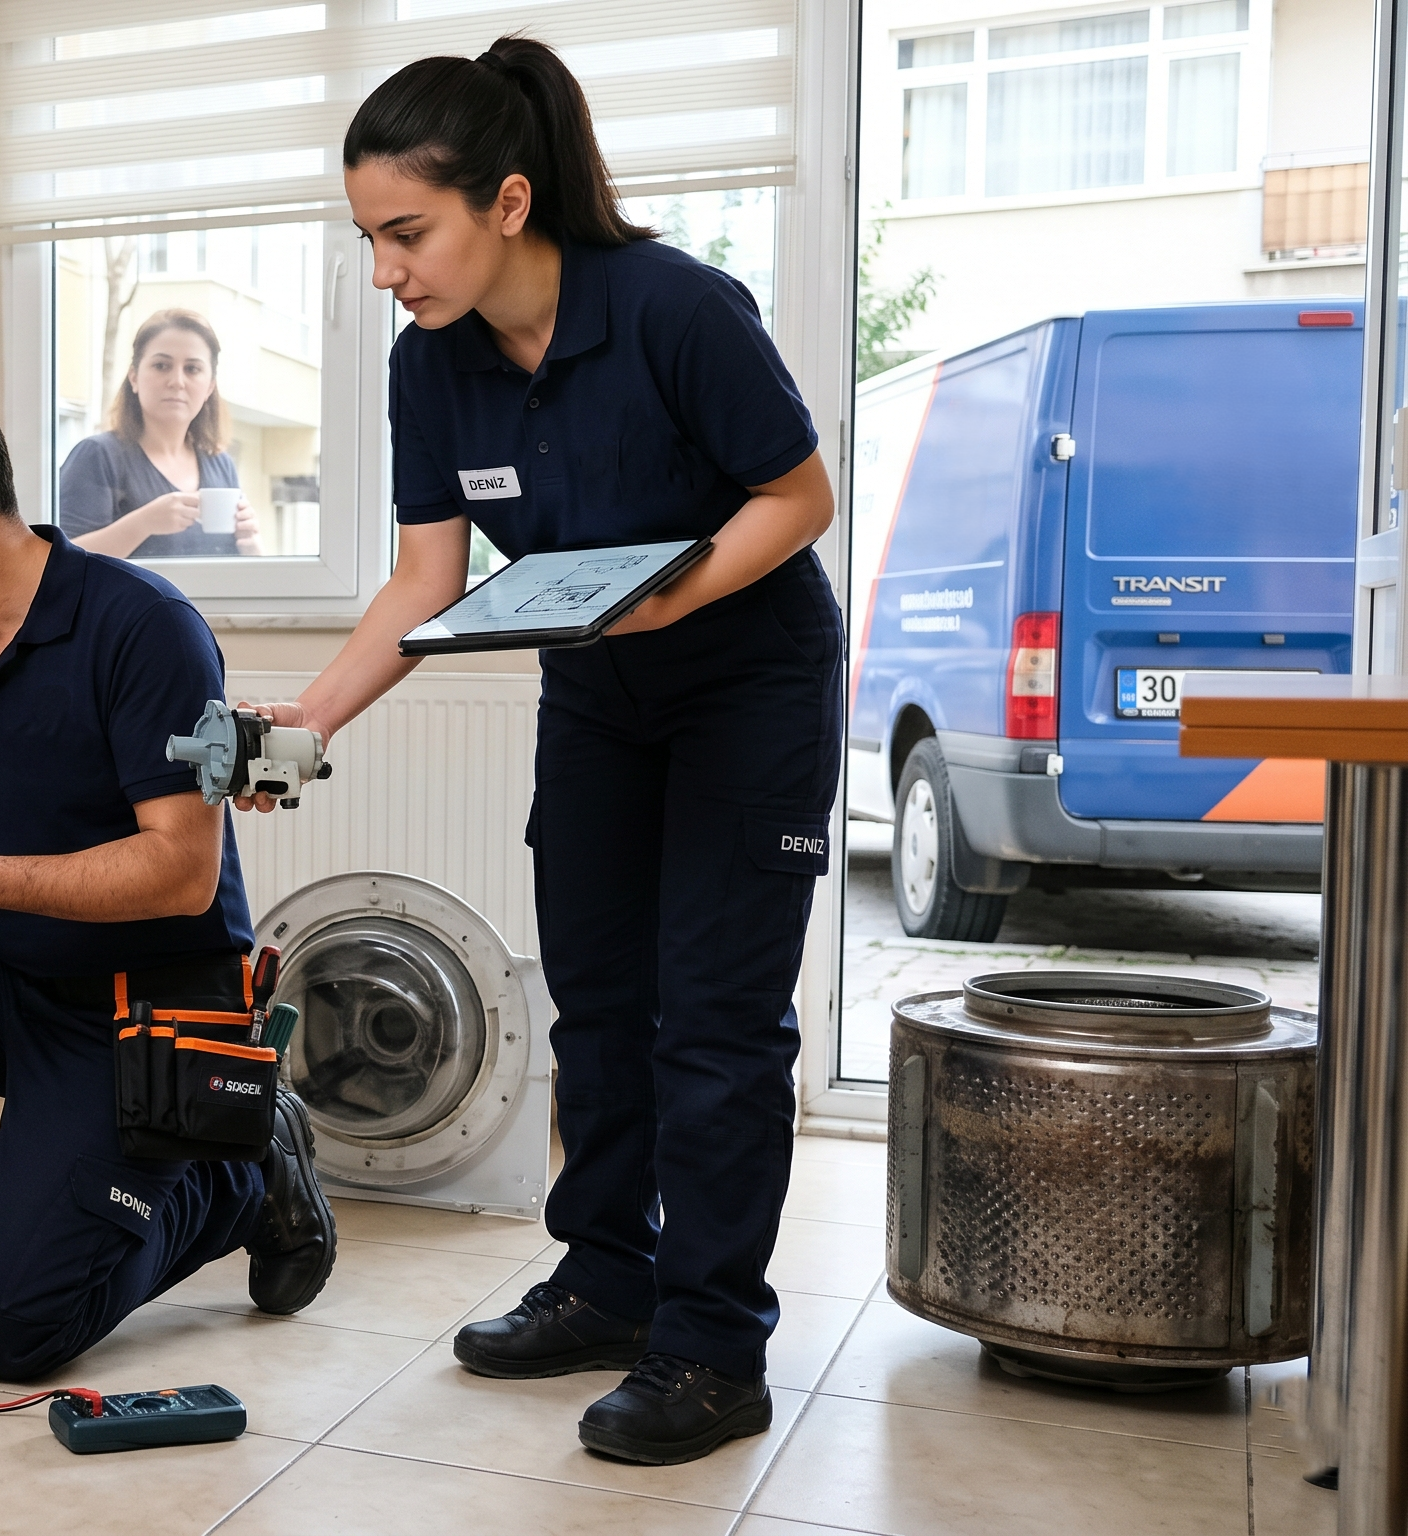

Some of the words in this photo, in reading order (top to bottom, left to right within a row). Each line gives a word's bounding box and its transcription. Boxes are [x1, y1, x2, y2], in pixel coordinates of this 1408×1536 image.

[468, 476, 507, 491] DENİZ
[1112, 576, 1227, 593] TRANSIT
[1142, 675, 1176, 703] 30
